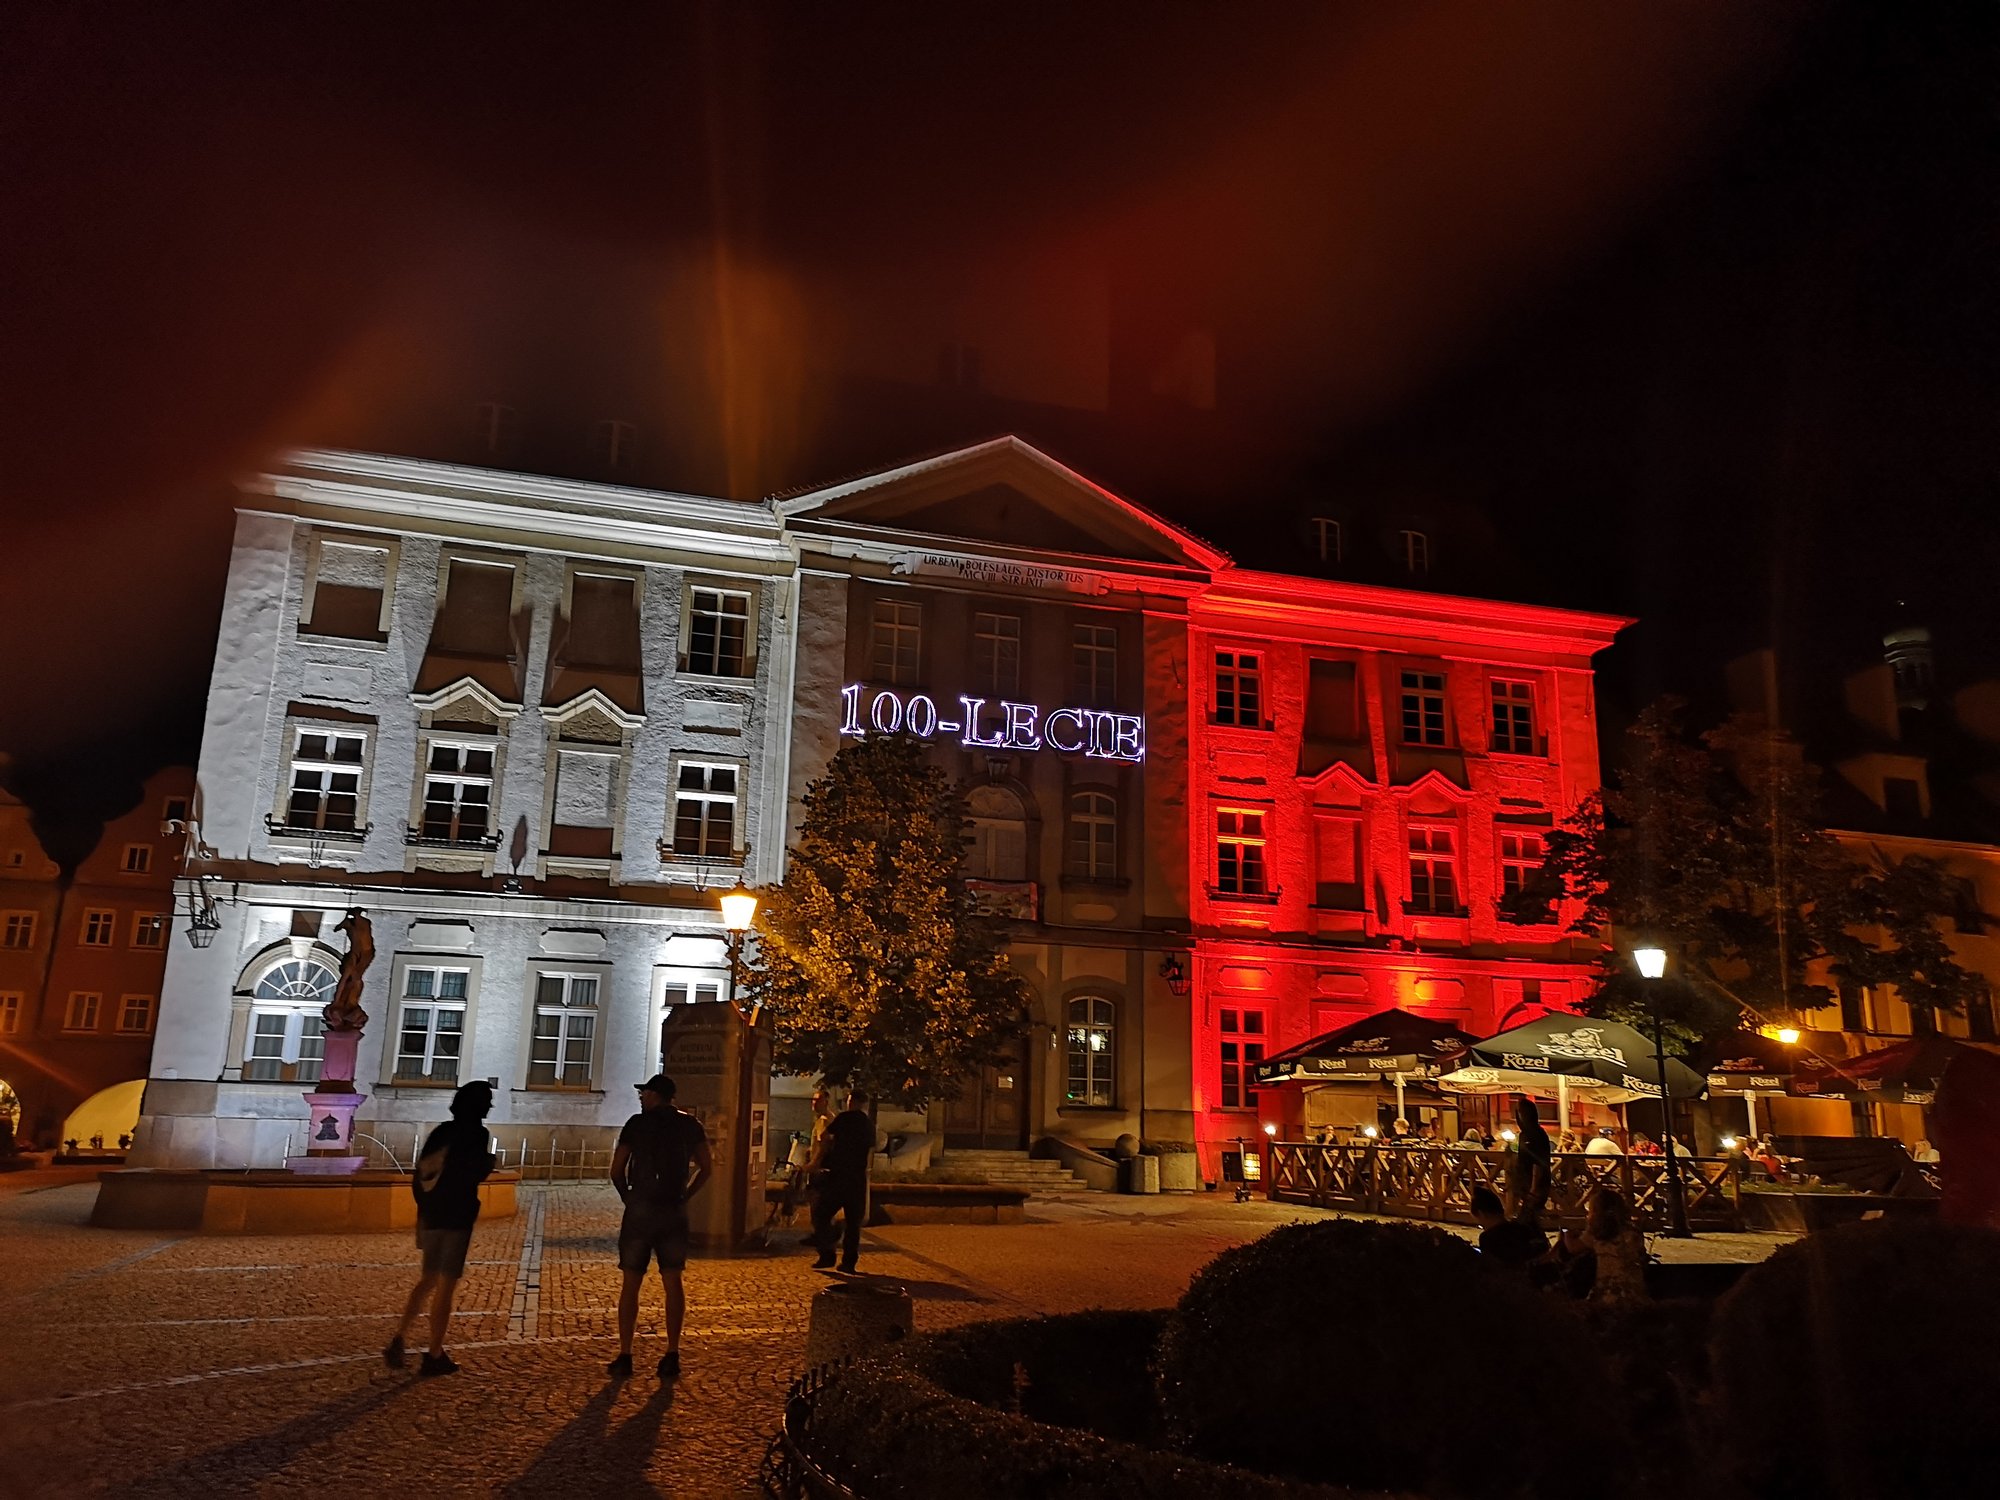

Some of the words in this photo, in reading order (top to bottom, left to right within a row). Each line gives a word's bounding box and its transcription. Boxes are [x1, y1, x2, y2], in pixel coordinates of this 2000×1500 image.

[923, 554, 960, 570] URBEM
[965, 560, 1022, 577] BOLESLAUS
[1026, 567, 1084, 585] DISTORTUS
[962, 570, 996, 583] MCVIII
[841, 684, 1145, 762] 100-LECIE
[1502, 1053, 1550, 1071] Kozel
[1536, 1043, 1628, 1068] Kozel
[1318, 1059, 1347, 1070] Kozel
[1368, 1058, 1398, 1069] Kozel
[1749, 1076, 1780, 1087] Kozel
